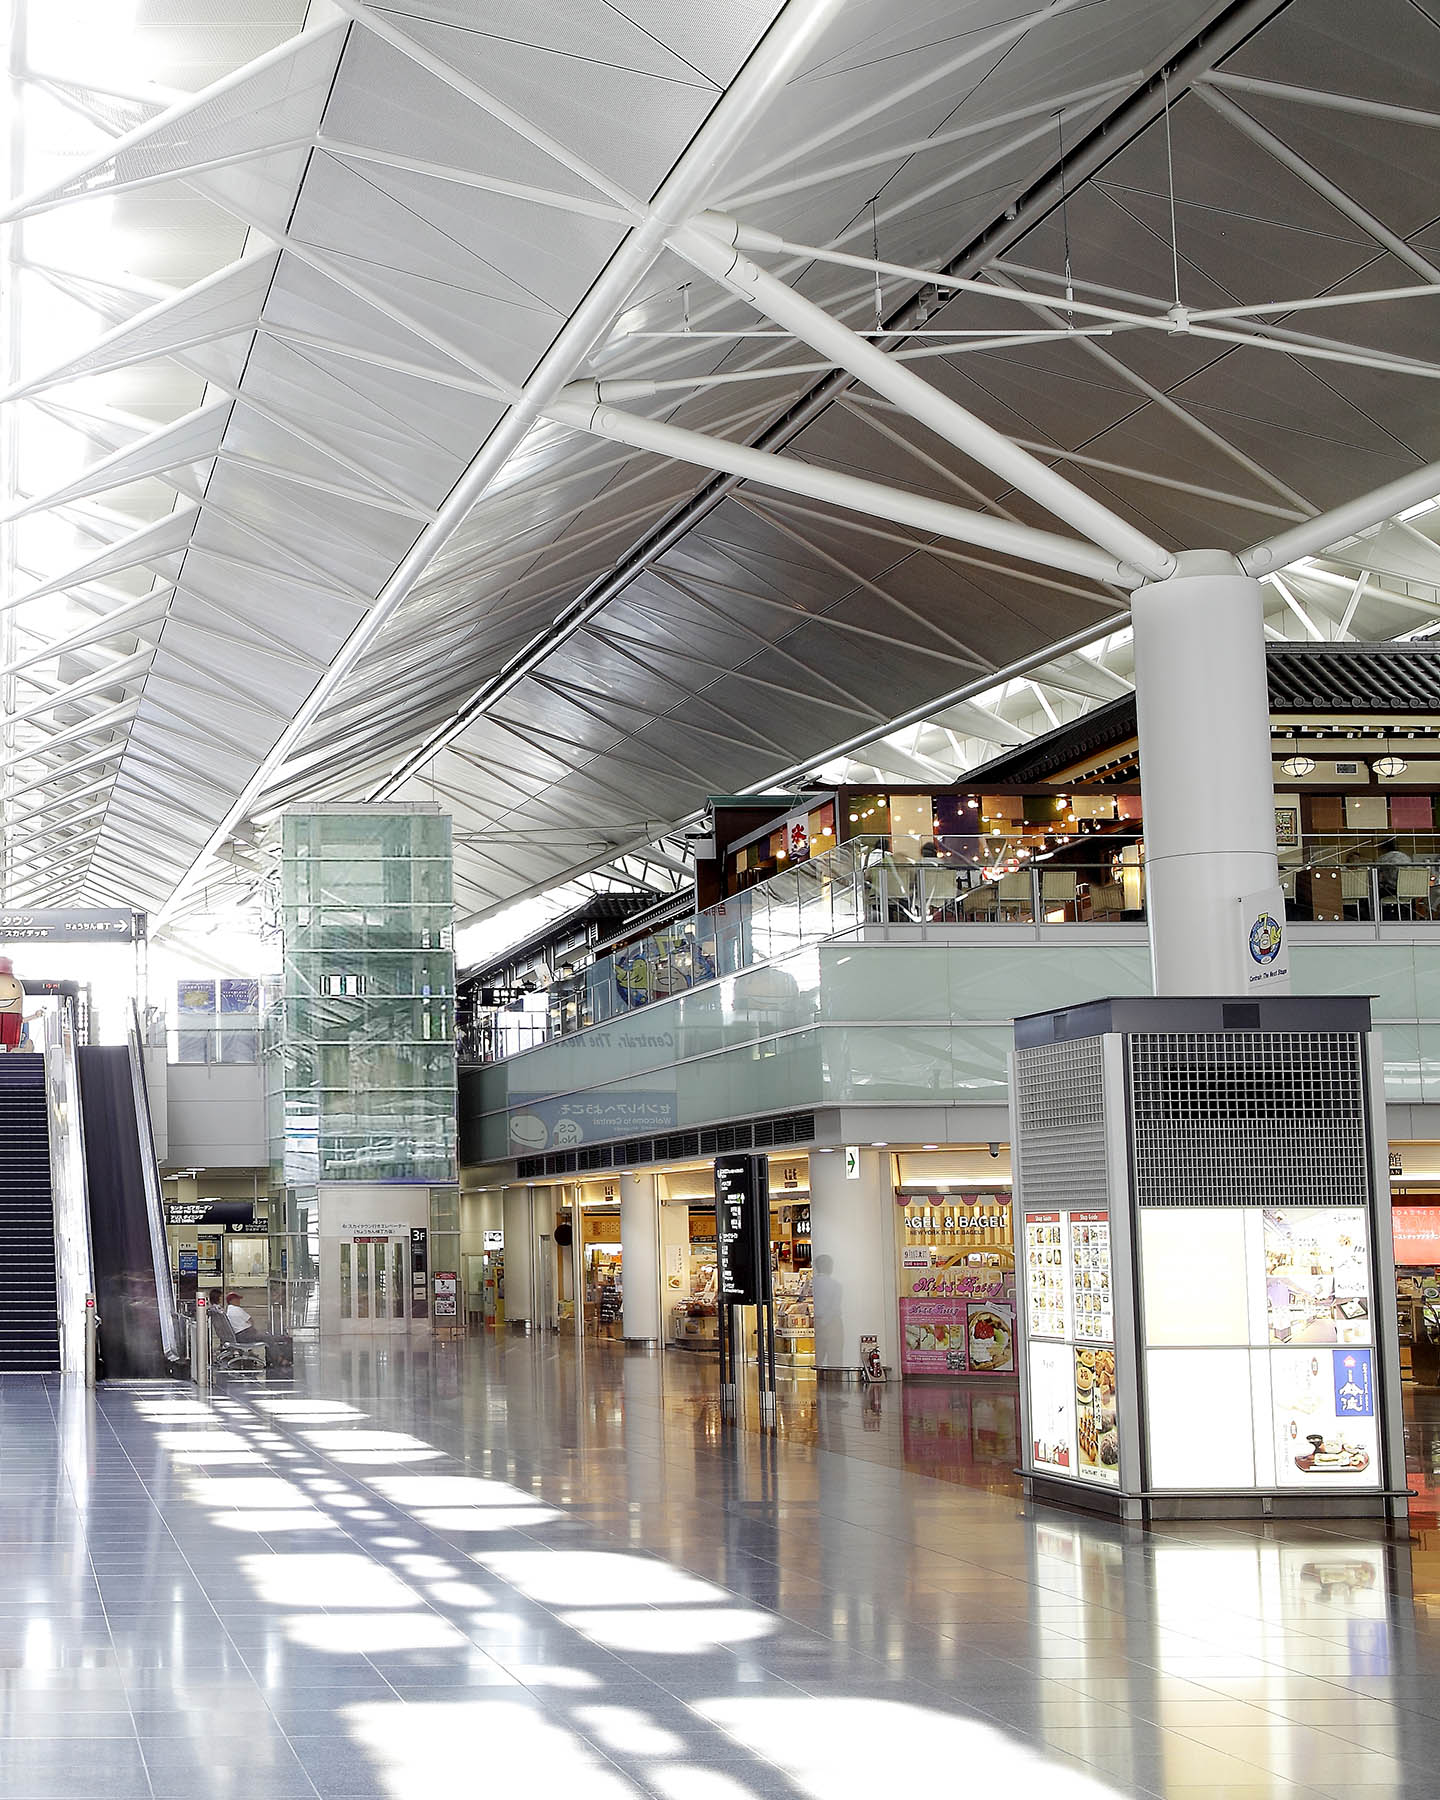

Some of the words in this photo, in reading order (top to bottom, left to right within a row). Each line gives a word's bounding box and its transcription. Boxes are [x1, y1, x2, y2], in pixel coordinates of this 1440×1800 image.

[65, 922, 111, 930] ちょうちん横丁
[944, 1216, 955, 1228] &
[958, 1216, 1006, 1228] BAGEL
[412, 1230, 425, 1241] 3F
